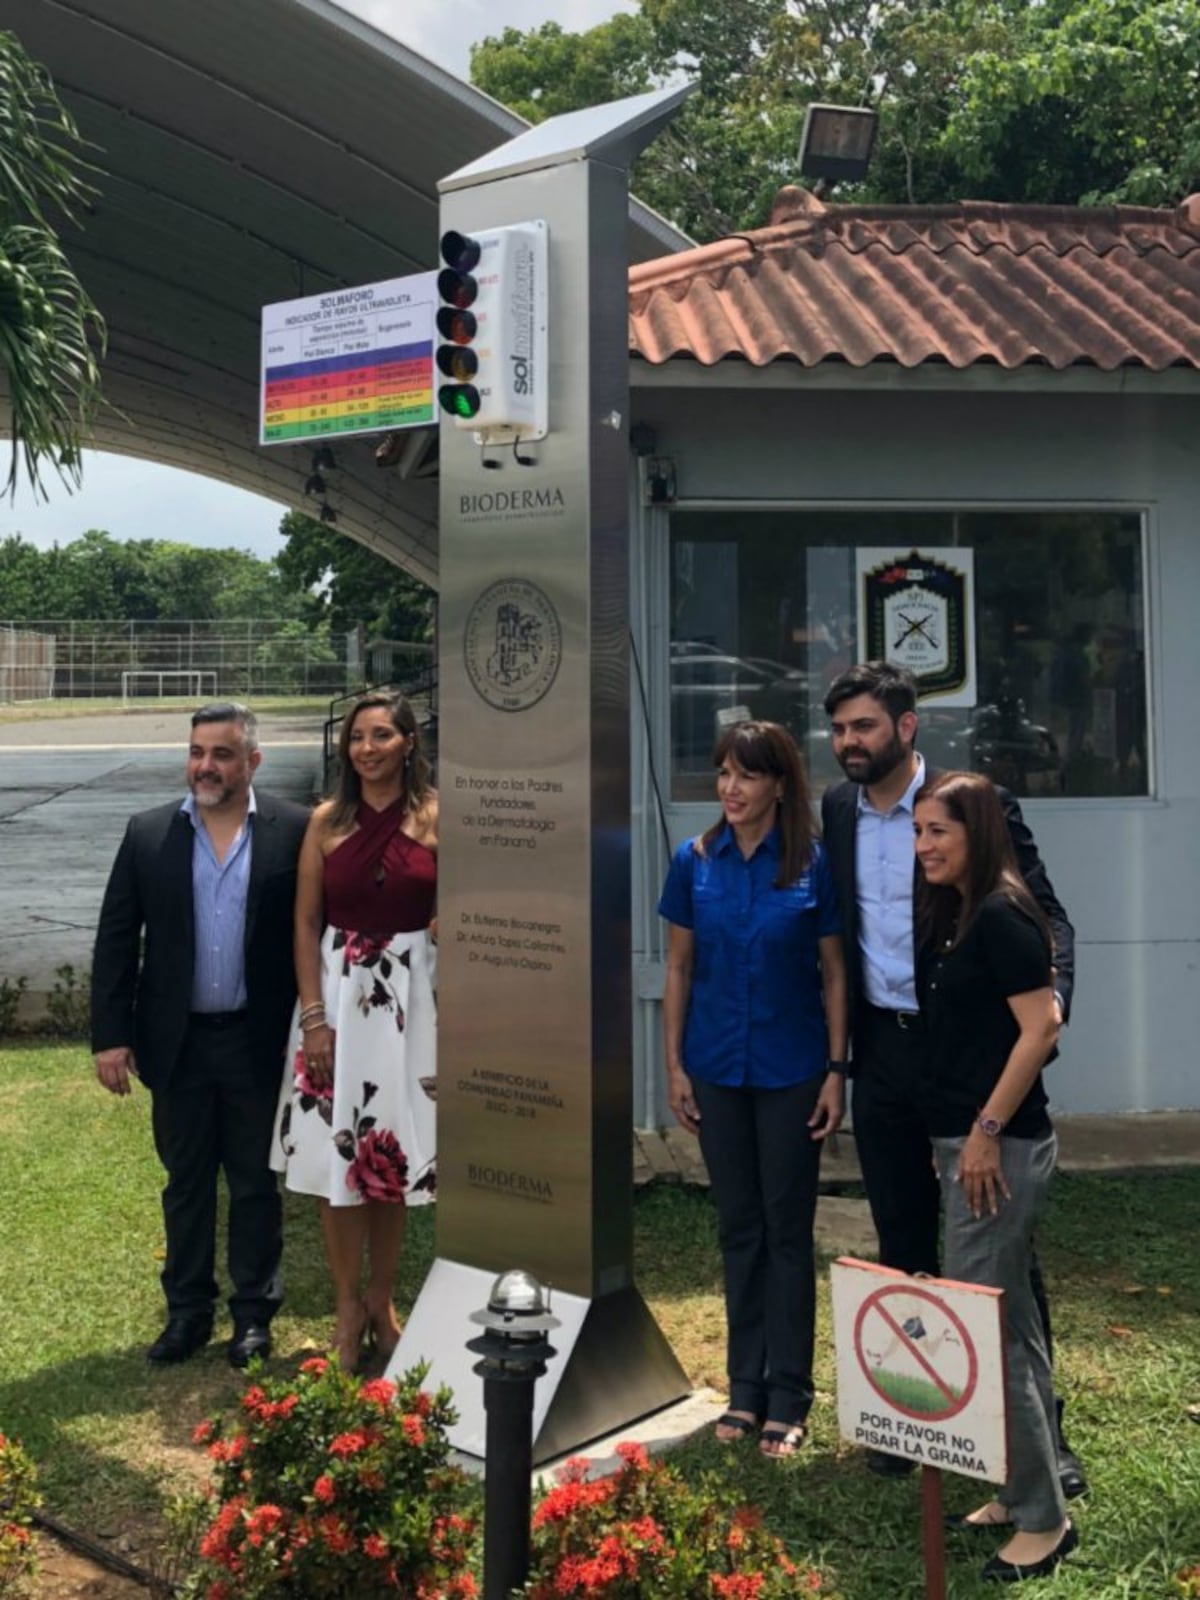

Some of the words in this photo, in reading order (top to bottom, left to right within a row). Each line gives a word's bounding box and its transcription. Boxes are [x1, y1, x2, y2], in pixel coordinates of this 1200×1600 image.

[285, 310, 322, 326] INDICADOR
[323, 309, 332, 319] DE
[334, 305, 359, 317] RAYOS
[360, 294, 412, 312] ULTRAVIOLETA
[460, 487, 565, 514] BIODERMA
[455, 776, 468, 789] En
[469, 776, 500, 790] honor
[501, 779, 510, 790] a
[511, 777, 525, 791] los
[527, 778, 563, 793] Padres
[480, 795, 536, 811] Fundadores
[462, 814, 475, 827] de
[477, 814, 487, 827] la
[479, 835, 492, 847] en
[457, 1079, 513, 1098] COMUNIDAD
[472, 1068, 478, 1078] A
[480, 1069, 524, 1087] BENEFICIO
[526, 1077, 538, 1089] DE
[539, 1080, 550, 1091] LA
[468, 1163, 554, 1198] BIODERMA
[860, 1411, 893, 1431] POR
[896, 1421, 946, 1445] FAVOR
[952, 1435, 976, 1453] NO
[855, 1427, 900, 1450] PISAR
[904, 1439, 924, 1456] LA
[927, 1448, 988, 1474] GRAMA
